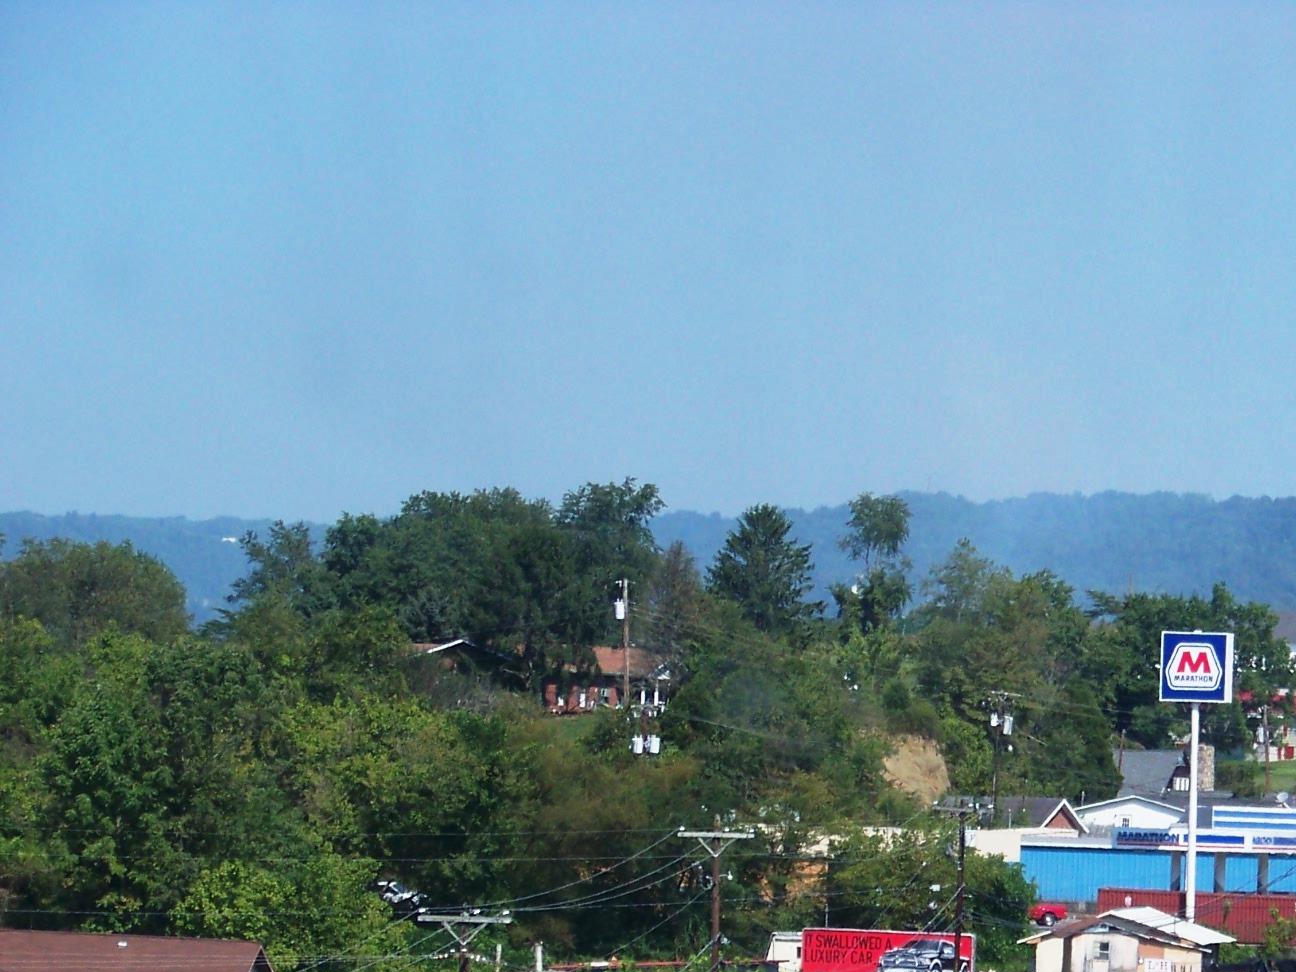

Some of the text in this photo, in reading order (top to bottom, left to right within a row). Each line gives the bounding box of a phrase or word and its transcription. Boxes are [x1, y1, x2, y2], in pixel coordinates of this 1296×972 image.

[1177, 651, 1211, 673] M
[1117, 831, 1180, 843] MARATHON
[815, 934, 882, 950] SWALLOWED
[885, 937, 892, 949] A
[805, 949, 846, 964] LUXURY
